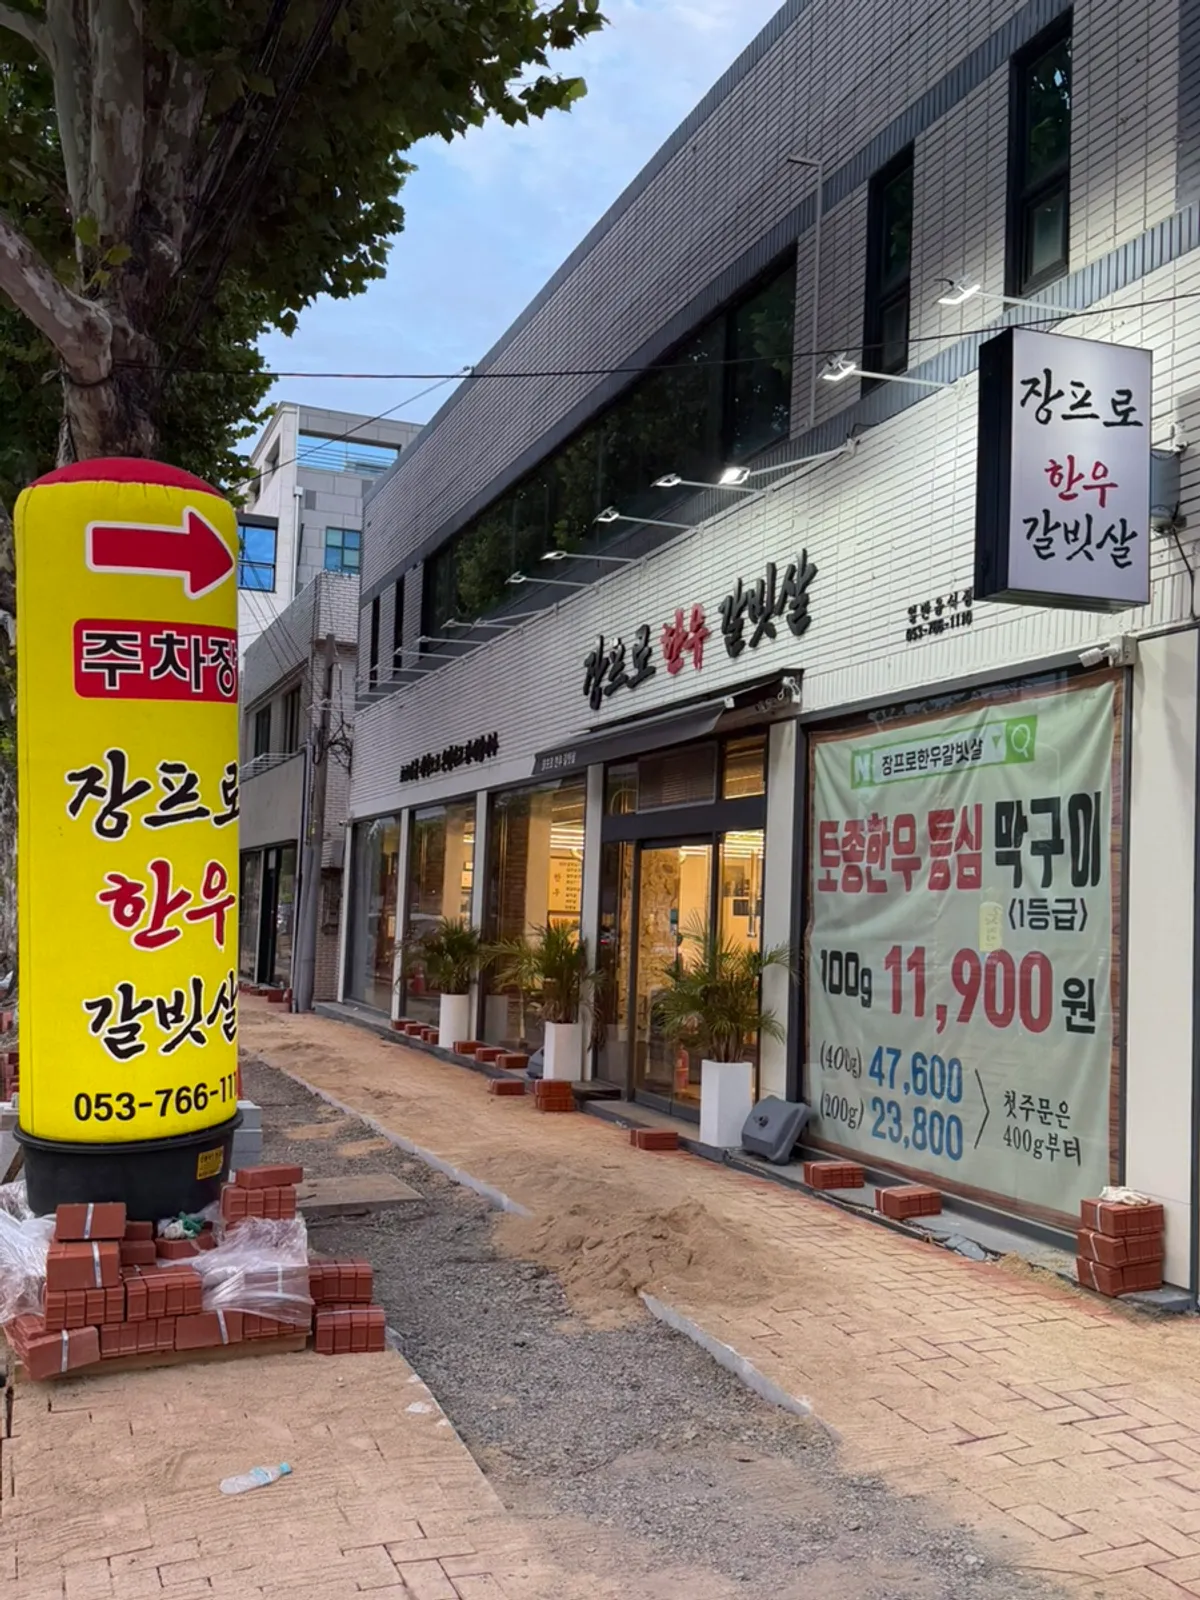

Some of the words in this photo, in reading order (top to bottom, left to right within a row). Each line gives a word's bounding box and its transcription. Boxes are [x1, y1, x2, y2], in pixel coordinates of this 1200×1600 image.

[1020, 368, 1143, 427] 장프로
[1044, 454, 1118, 508] 한우
[1022, 508, 1138, 569] 갈빗살
[81, 630, 237, 697] 주차장
[583, 634, 657, 711] 장프로
[660, 602, 711, 675] 한우
[718, 548, 818, 658] 갈빗살
[66, 748, 239, 840] 장프로
[881, 738, 984, 777] 장프로한우갈빗살
[927, 803, 983, 891] 등심
[994, 791, 1102, 889] 막구이
[98, 858, 236, 948] 한우
[85, 969, 238, 1060] 갈빗살
[820, 949, 872, 1008] 100g
[884, 945, 1054, 1034] 11,900
[1061, 977, 1096, 1035] 원
[868, 1045, 963, 1104] 47,600
[820, 1089, 864, 1130] (200g)
[870, 1096, 963, 1162] 23,800
